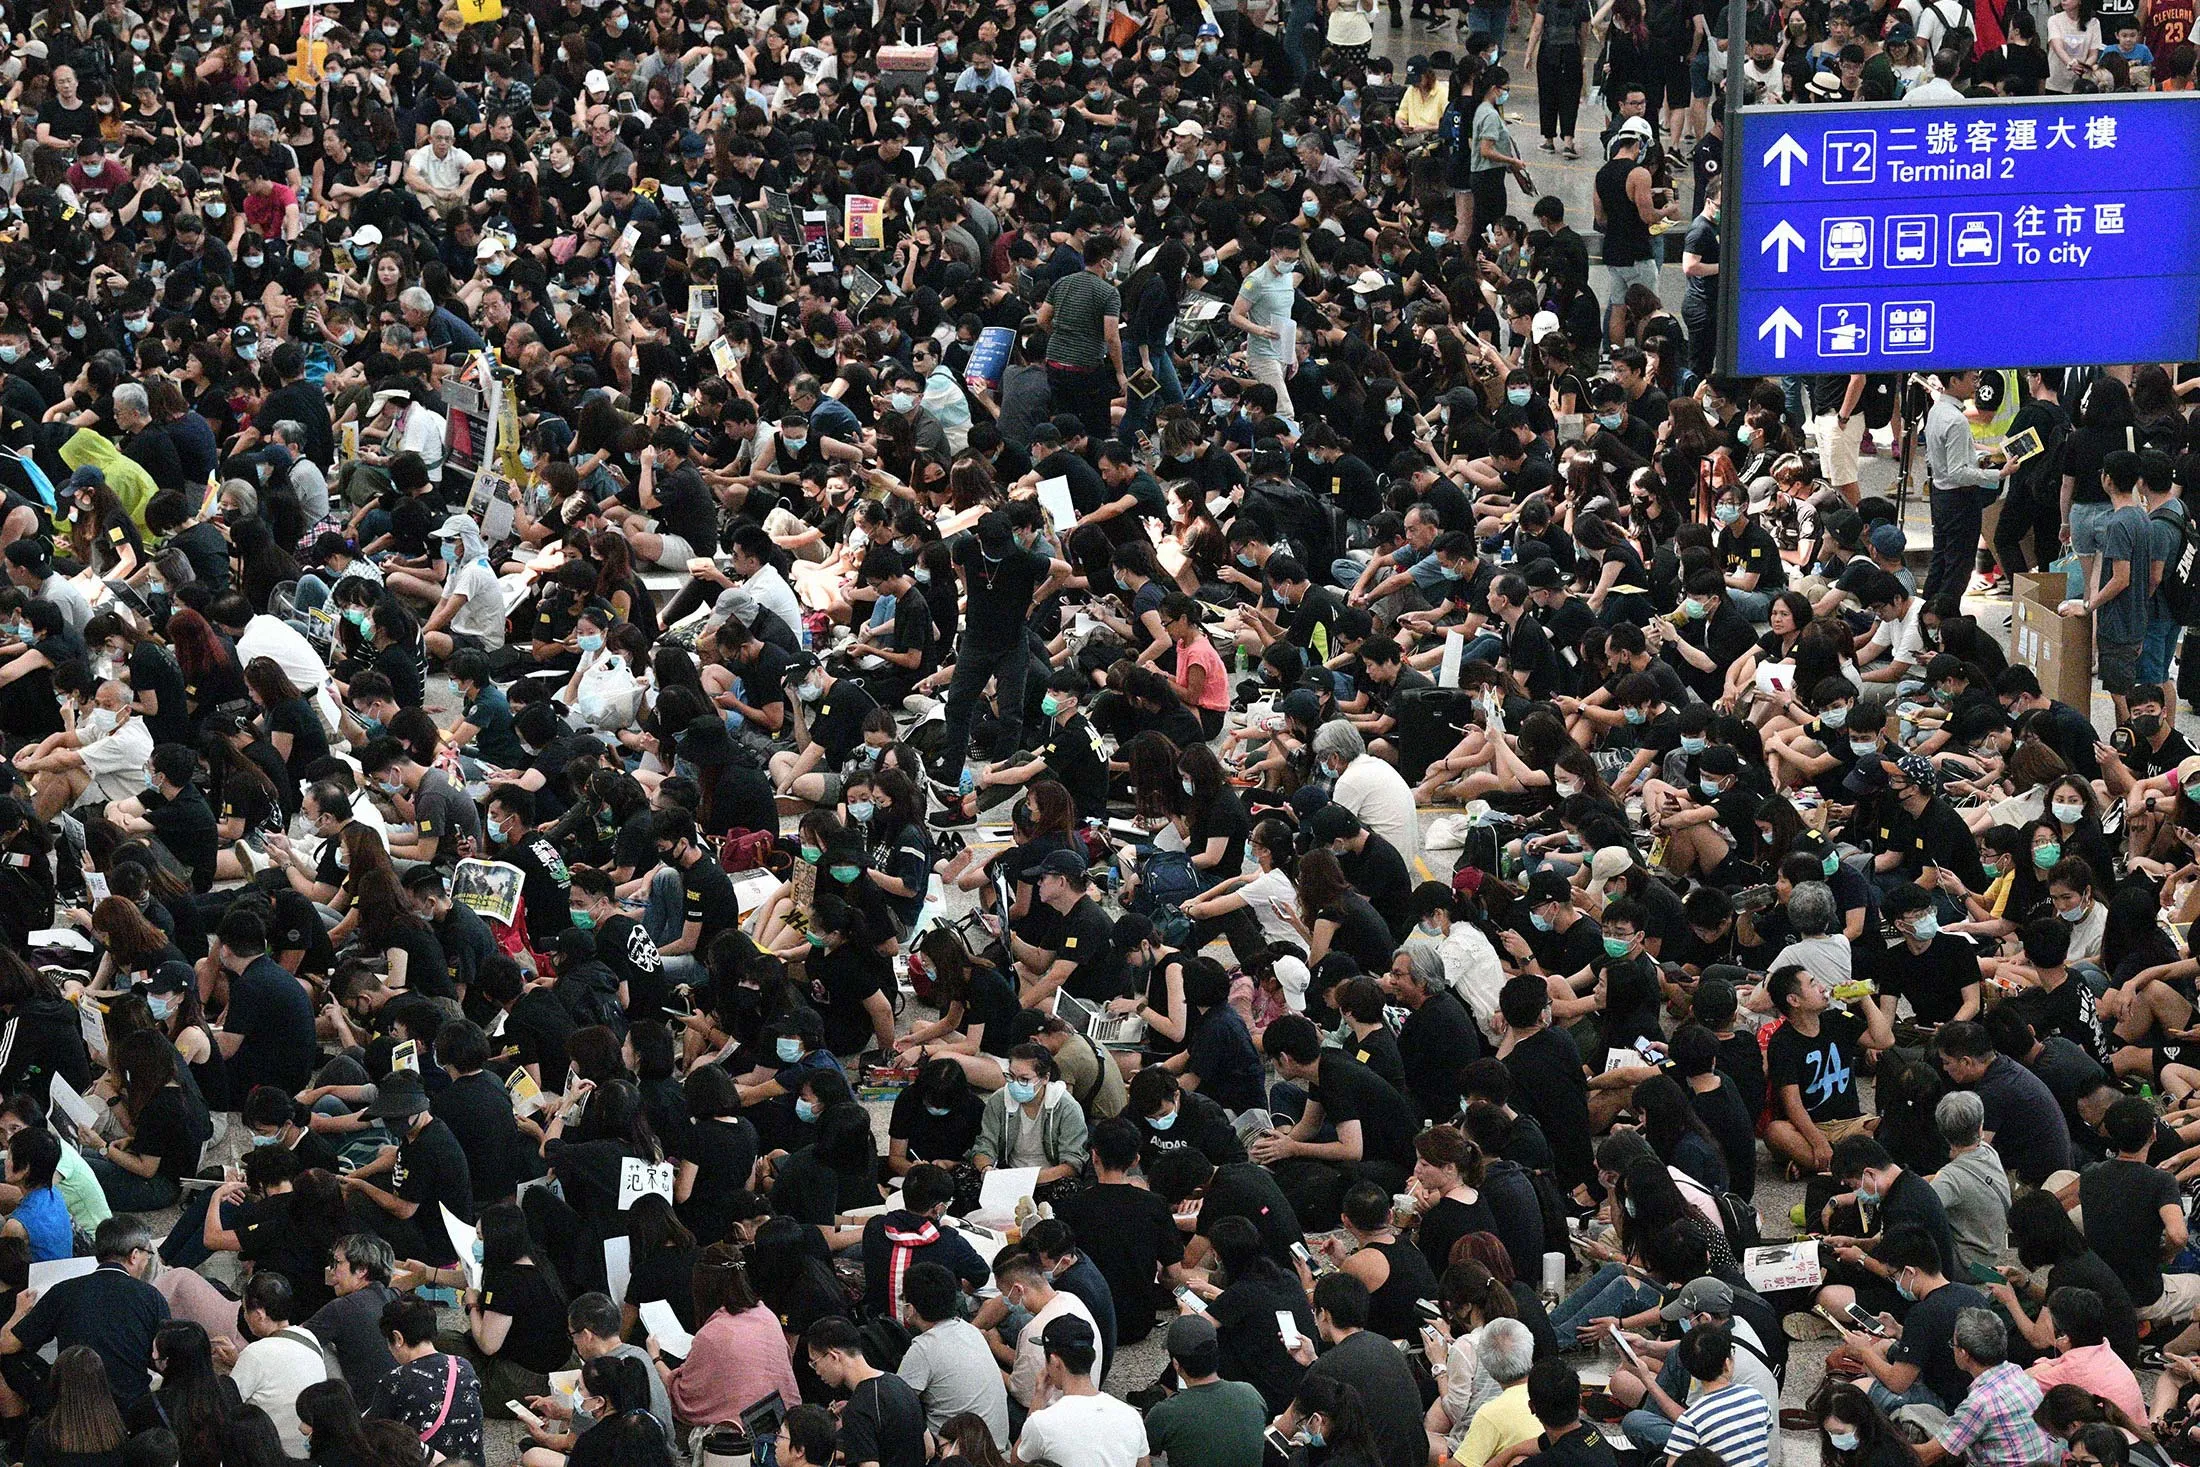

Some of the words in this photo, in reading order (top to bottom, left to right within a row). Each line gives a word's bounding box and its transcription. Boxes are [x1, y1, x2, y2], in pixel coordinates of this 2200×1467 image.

[2102, 0, 2135, 11] FILA
[2164, 22, 2184, 43] 23
[1887, 115, 2118, 155] 二號客運大樓
[1828, 142, 1872, 173] T2
[1887, 158, 1991, 182] Terminal
[2000, 157, 2015, 179] 2
[2012, 203, 2126, 239] 往市區
[2012, 243, 2040, 265] To
[2049, 242, 2092, 267] city
[1150, 1136, 1188, 1149] ADIDAS
